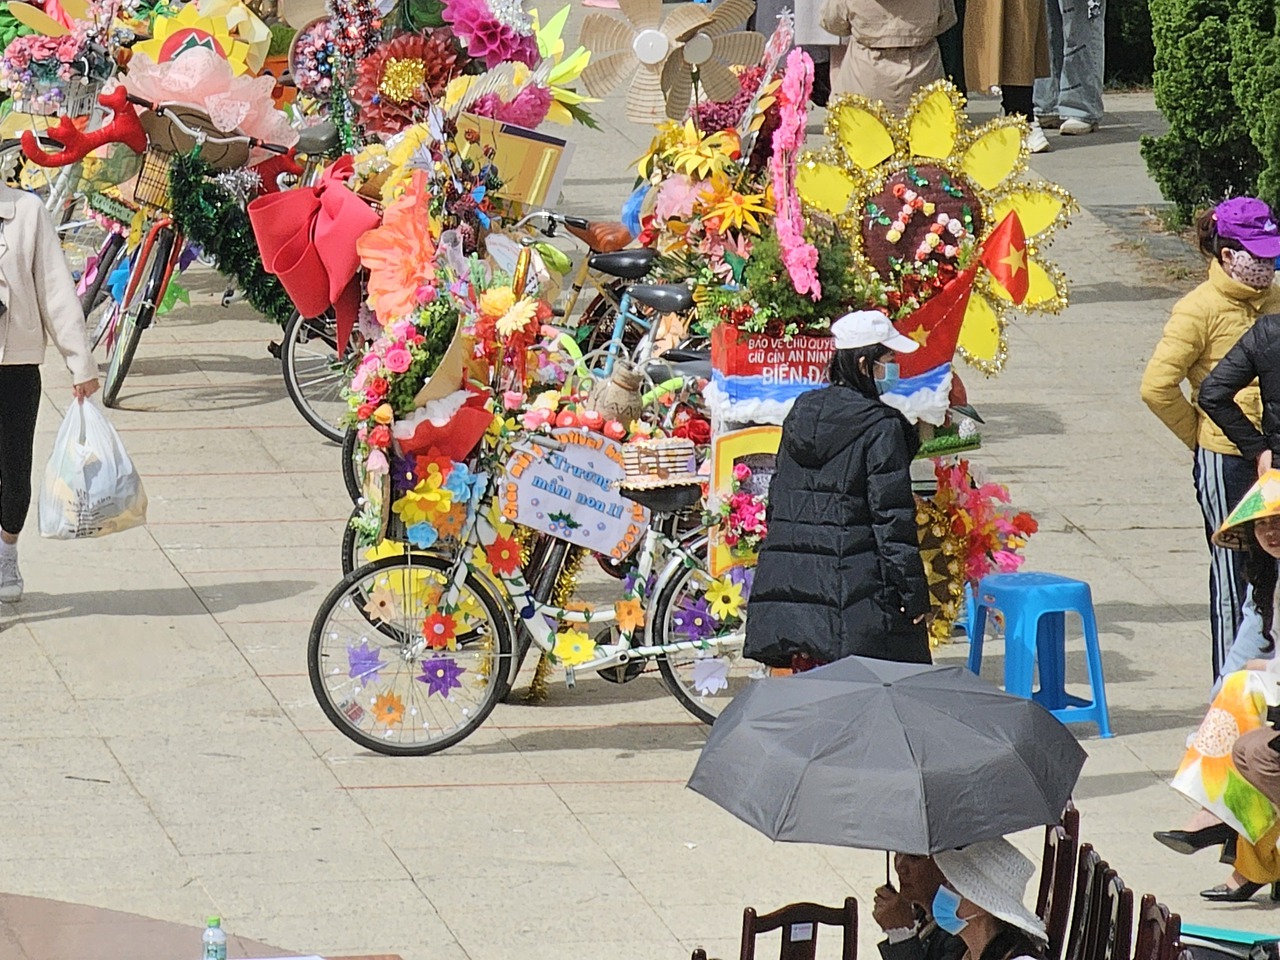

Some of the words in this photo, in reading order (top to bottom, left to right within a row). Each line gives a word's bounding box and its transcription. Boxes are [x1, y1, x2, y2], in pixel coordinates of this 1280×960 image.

[748, 350, 765, 363] GIỮ
[788, 350, 805, 363] AN
[552, 452, 614, 492] Trường
[502, 482, 518, 519] Chào
[531, 474, 571, 500] mầm
[575, 492, 606, 513] non
